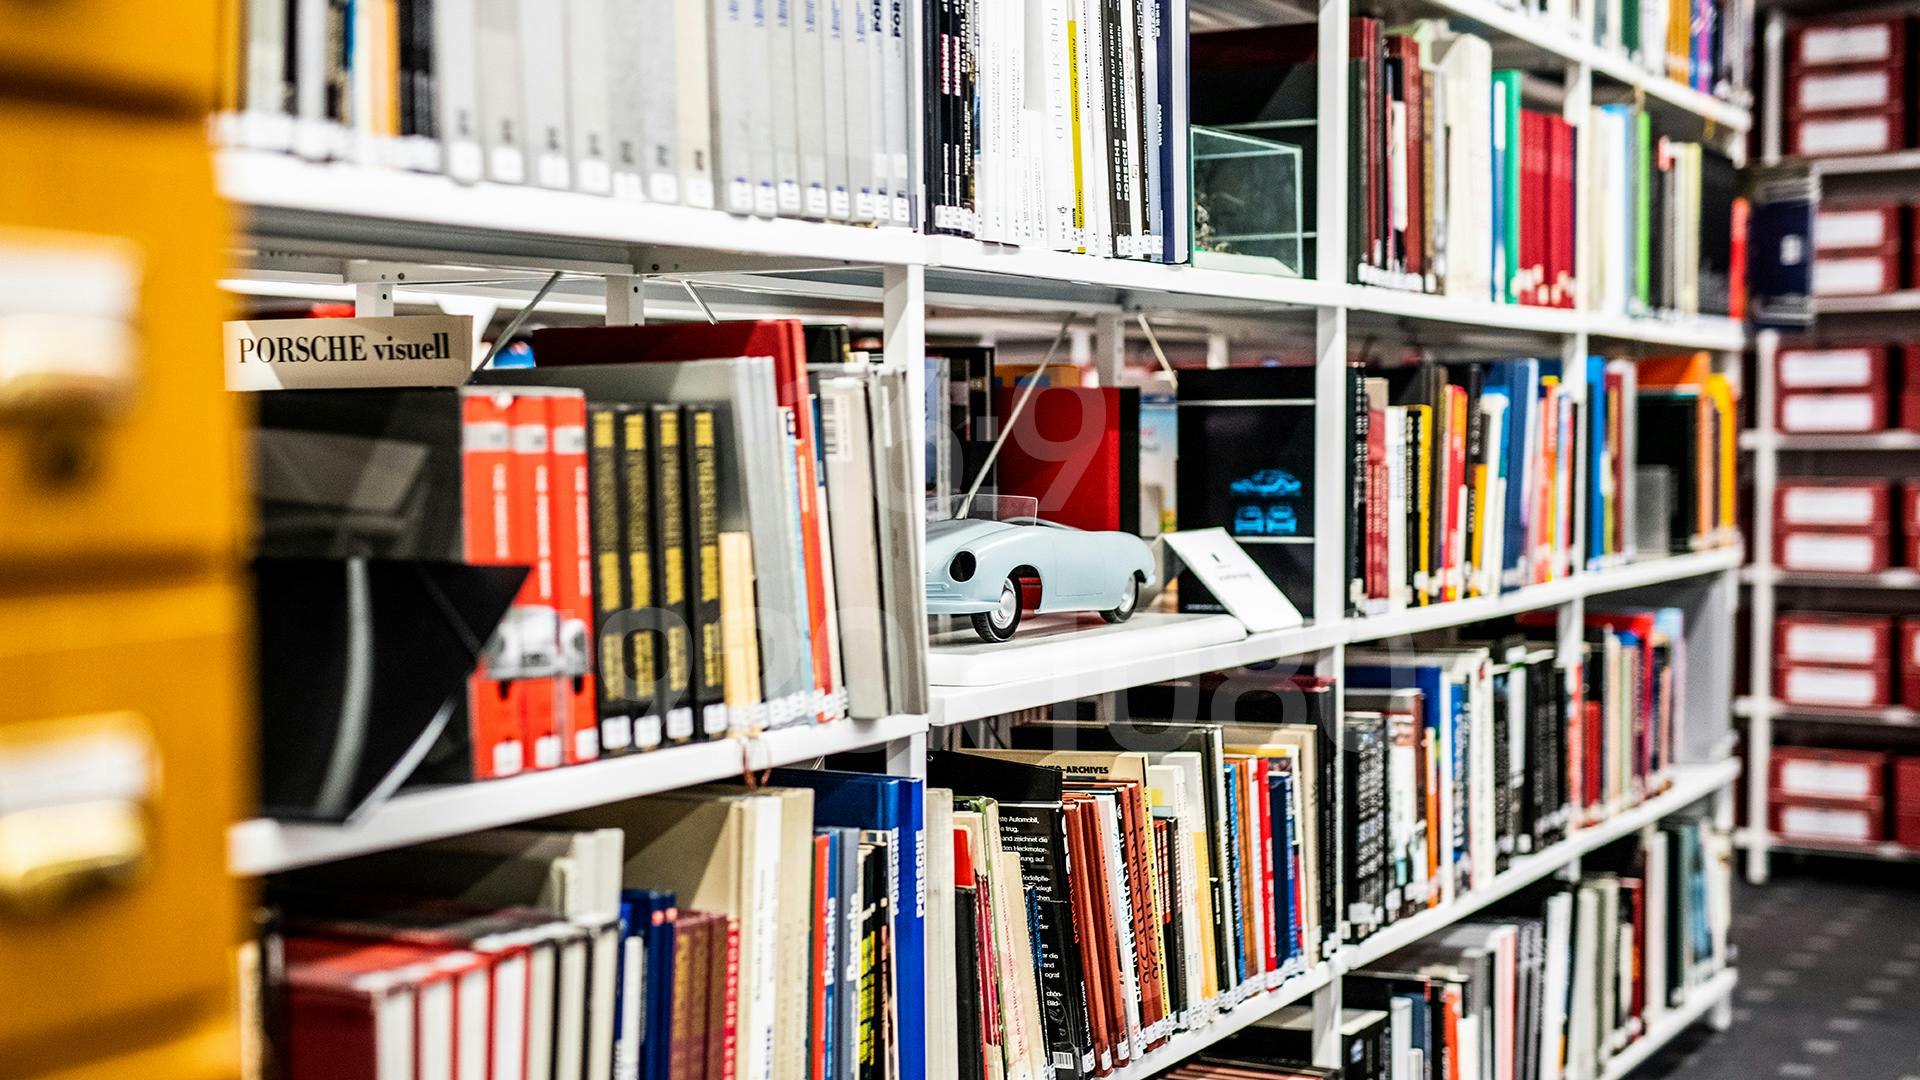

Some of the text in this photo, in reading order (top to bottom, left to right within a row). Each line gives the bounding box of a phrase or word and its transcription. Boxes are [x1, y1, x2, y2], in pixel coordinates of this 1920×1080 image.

[1113, 138, 1122, 200] PORSCHE
[1121, 139, 1129, 200] PORSCHE
[239, 333, 449, 363] PORSCHE visuell
[889, 826, 900, 916] PORSCHE
[914, 830, 925, 917] PORSCHE
[824, 897, 836, 985] Porsche
